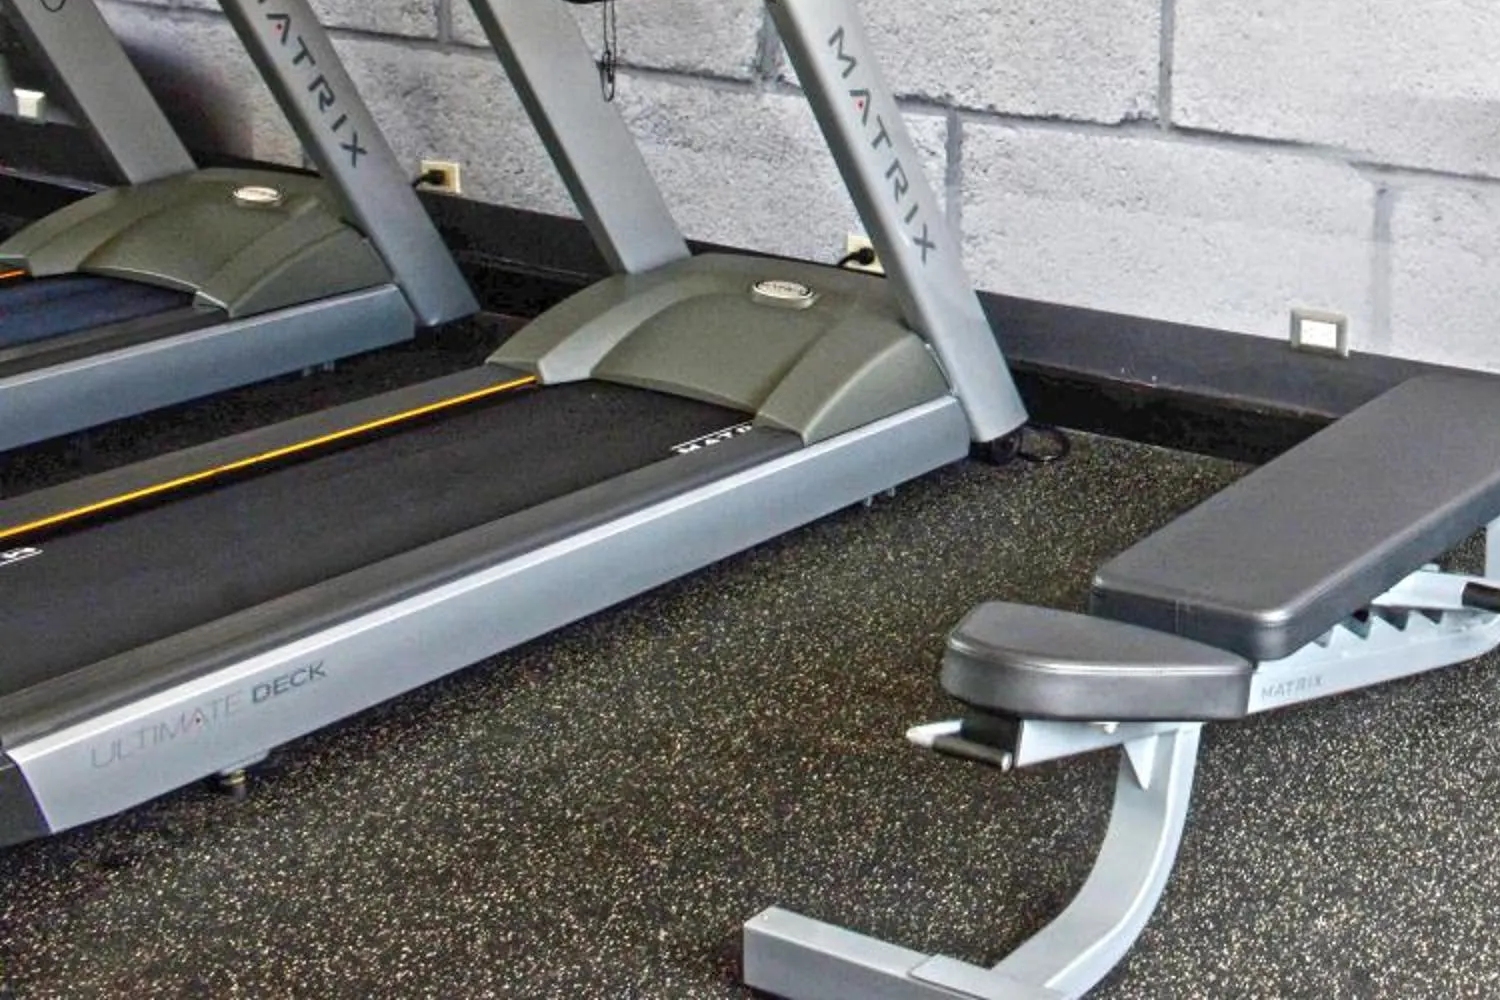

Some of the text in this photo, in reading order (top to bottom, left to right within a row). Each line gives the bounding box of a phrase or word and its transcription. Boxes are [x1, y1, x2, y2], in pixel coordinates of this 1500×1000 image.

[828, 25, 936, 265] MATRIX
[90, 660, 328, 769] ULTIMATE DECK
[1261, 674, 1324, 700] MATRIX
